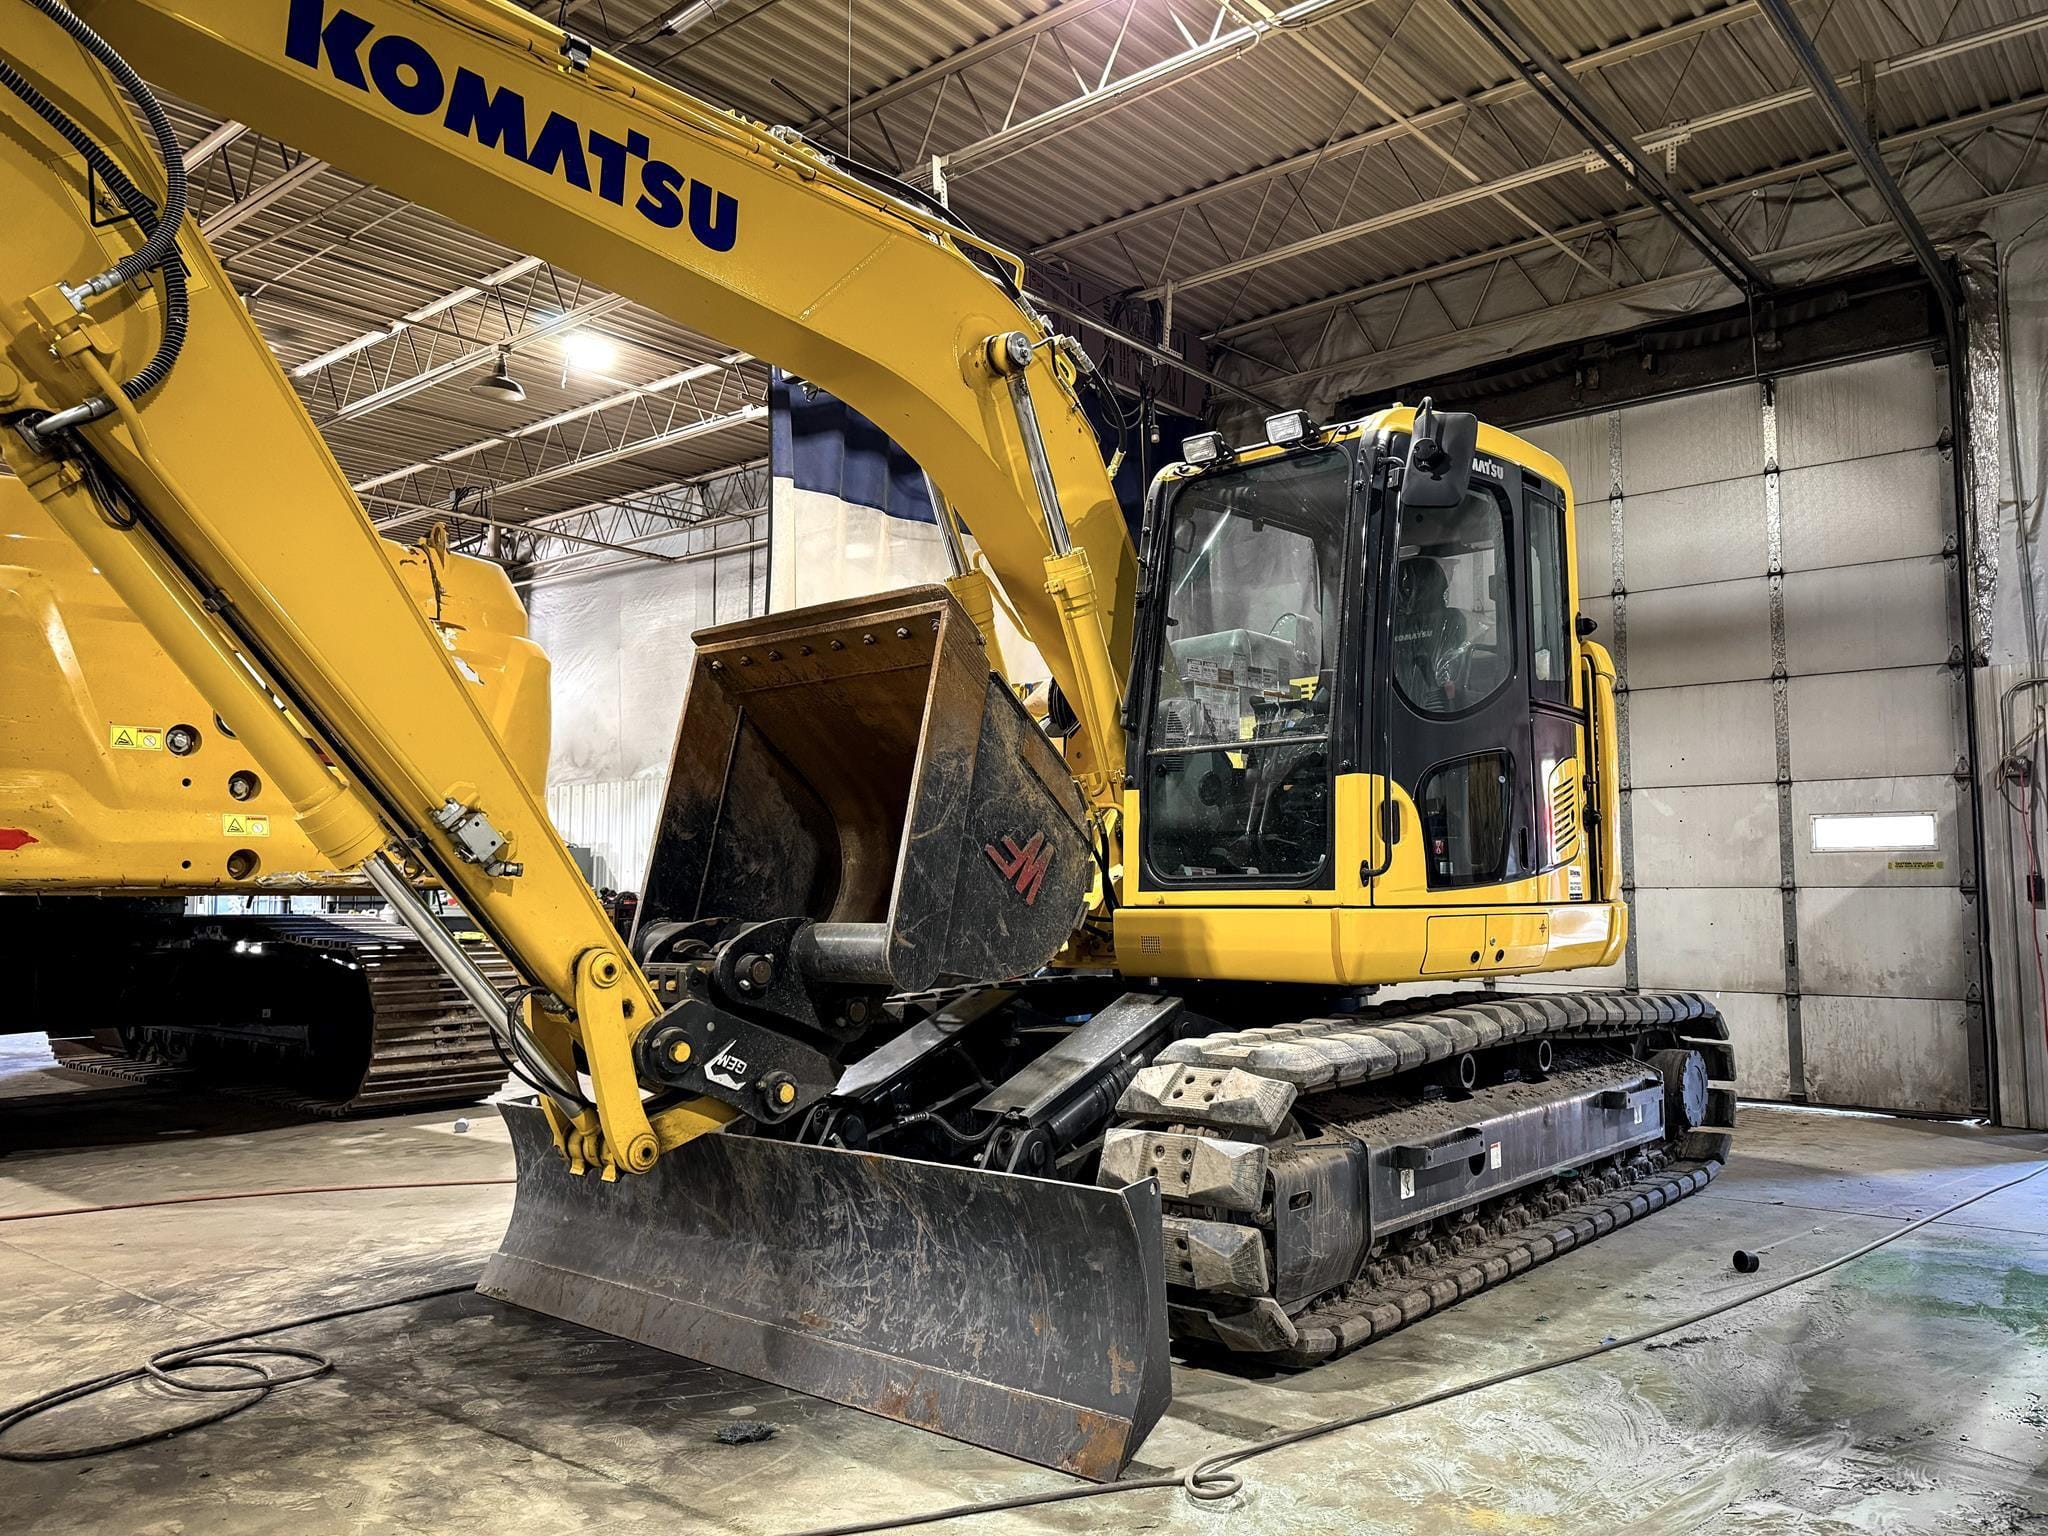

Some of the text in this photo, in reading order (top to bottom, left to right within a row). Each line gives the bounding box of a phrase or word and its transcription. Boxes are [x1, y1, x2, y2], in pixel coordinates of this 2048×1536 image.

[284, 0, 739, 253] KOMATSU
[1472, 457, 1504, 480] MATSU
[717, 1054, 747, 1075] GEM
